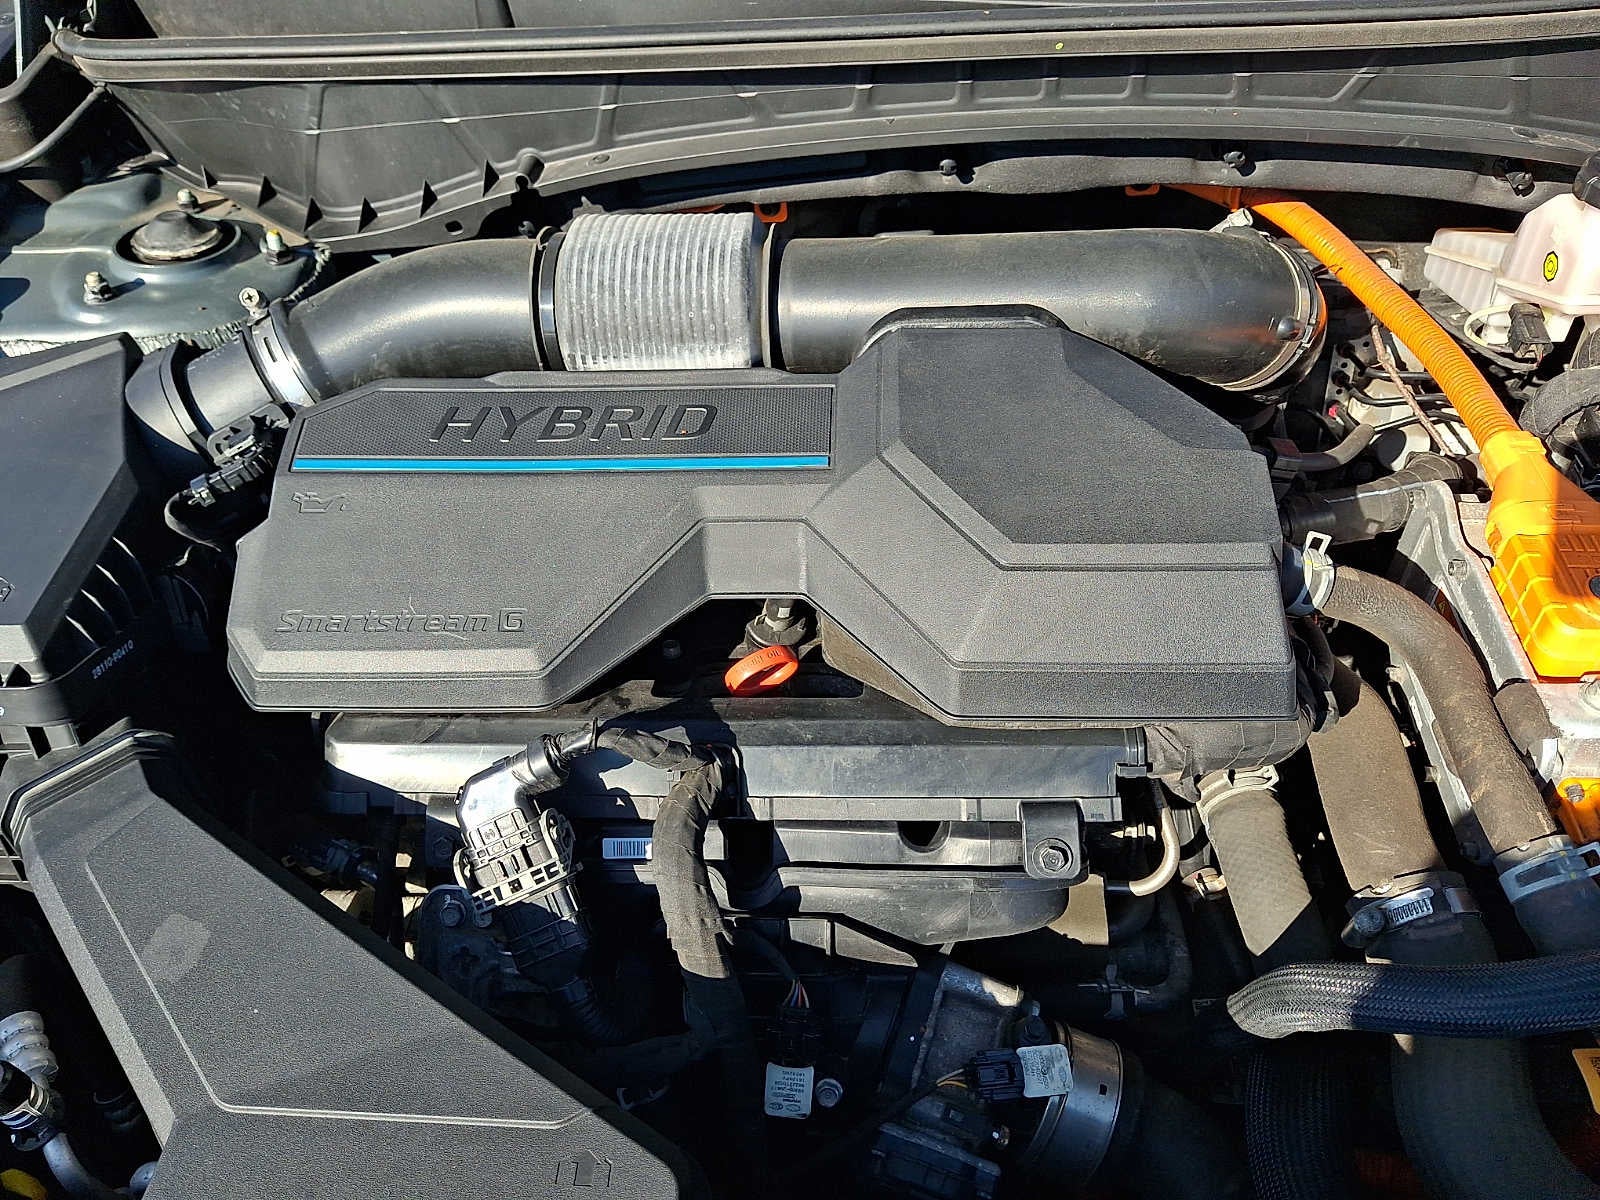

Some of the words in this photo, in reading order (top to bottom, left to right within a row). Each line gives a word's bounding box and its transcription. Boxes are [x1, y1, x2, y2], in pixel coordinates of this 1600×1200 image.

[429, 405, 718, 441] HYBRID
[275, 609, 492, 632] Smartstream
[500, 609, 526, 632] G
